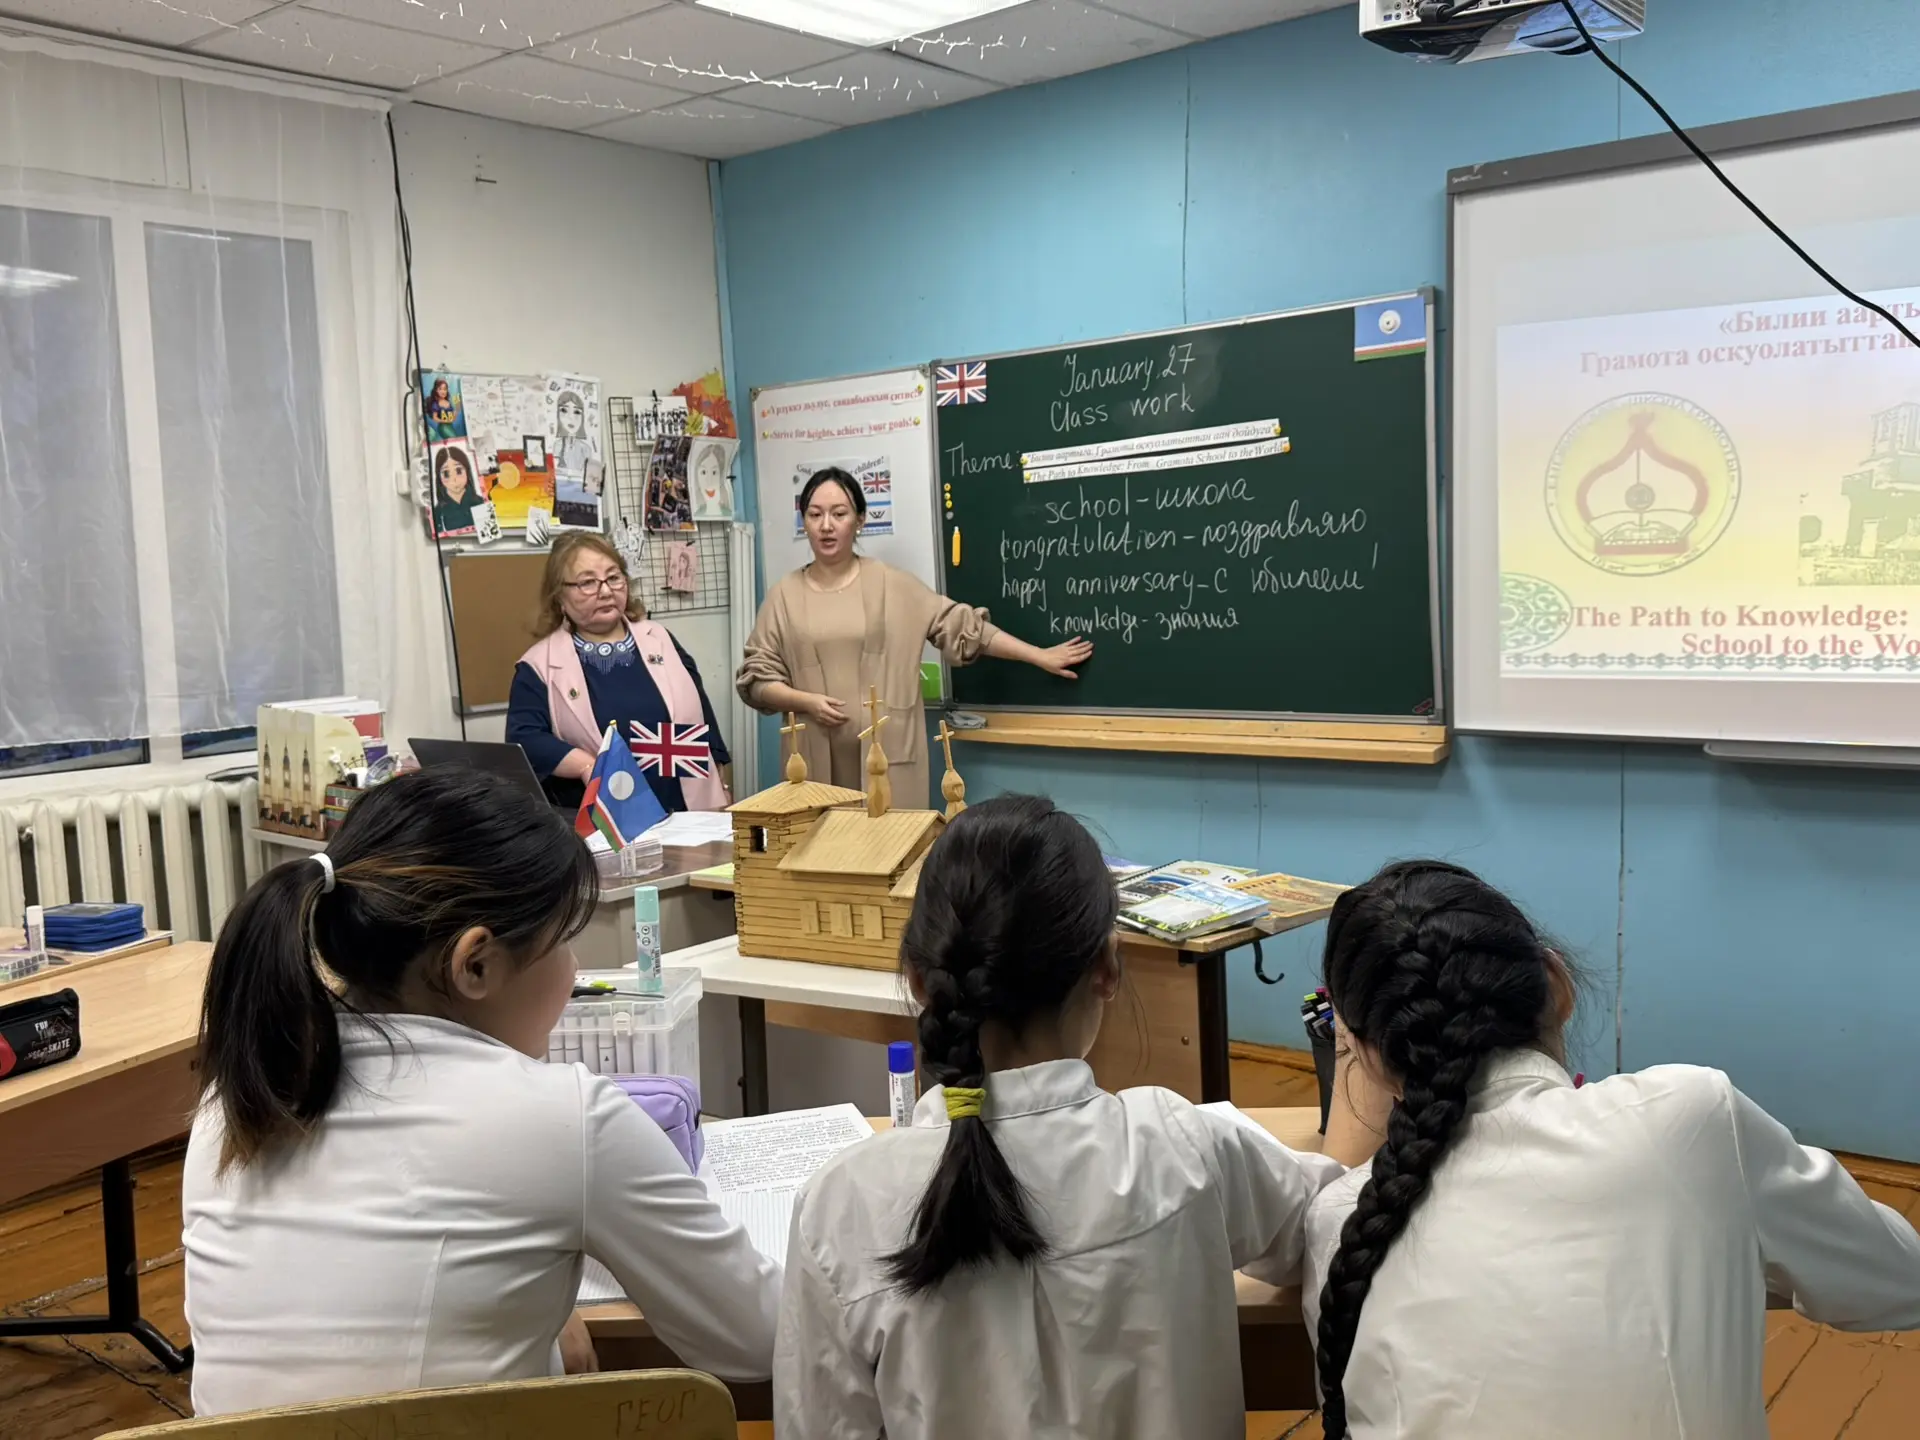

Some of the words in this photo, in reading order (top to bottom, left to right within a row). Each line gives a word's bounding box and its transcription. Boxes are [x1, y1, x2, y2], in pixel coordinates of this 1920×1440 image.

[1719, 309, 1828, 335] «Билии
[1162, 343, 1196, 377] 27
[1580, 349, 1690, 377] Грамота
[1050, 400, 1109, 432] Class
[1130, 382, 1196, 417] work
[836, 424, 864, 436] achieve
[868, 423, 887, 434] your
[1126, 459, 1149, 470] From
[1195, 450, 1226, 463] School
[1002, 564, 1047, 612] happy
[1630, 606, 1692, 627] Path
[1701, 608, 1727, 627] to
[1736, 604, 1908, 632] Knowledge:
[1682, 633, 1772, 655] School
[1782, 635, 1808, 655] to
[1819, 634, 1863, 655] the
